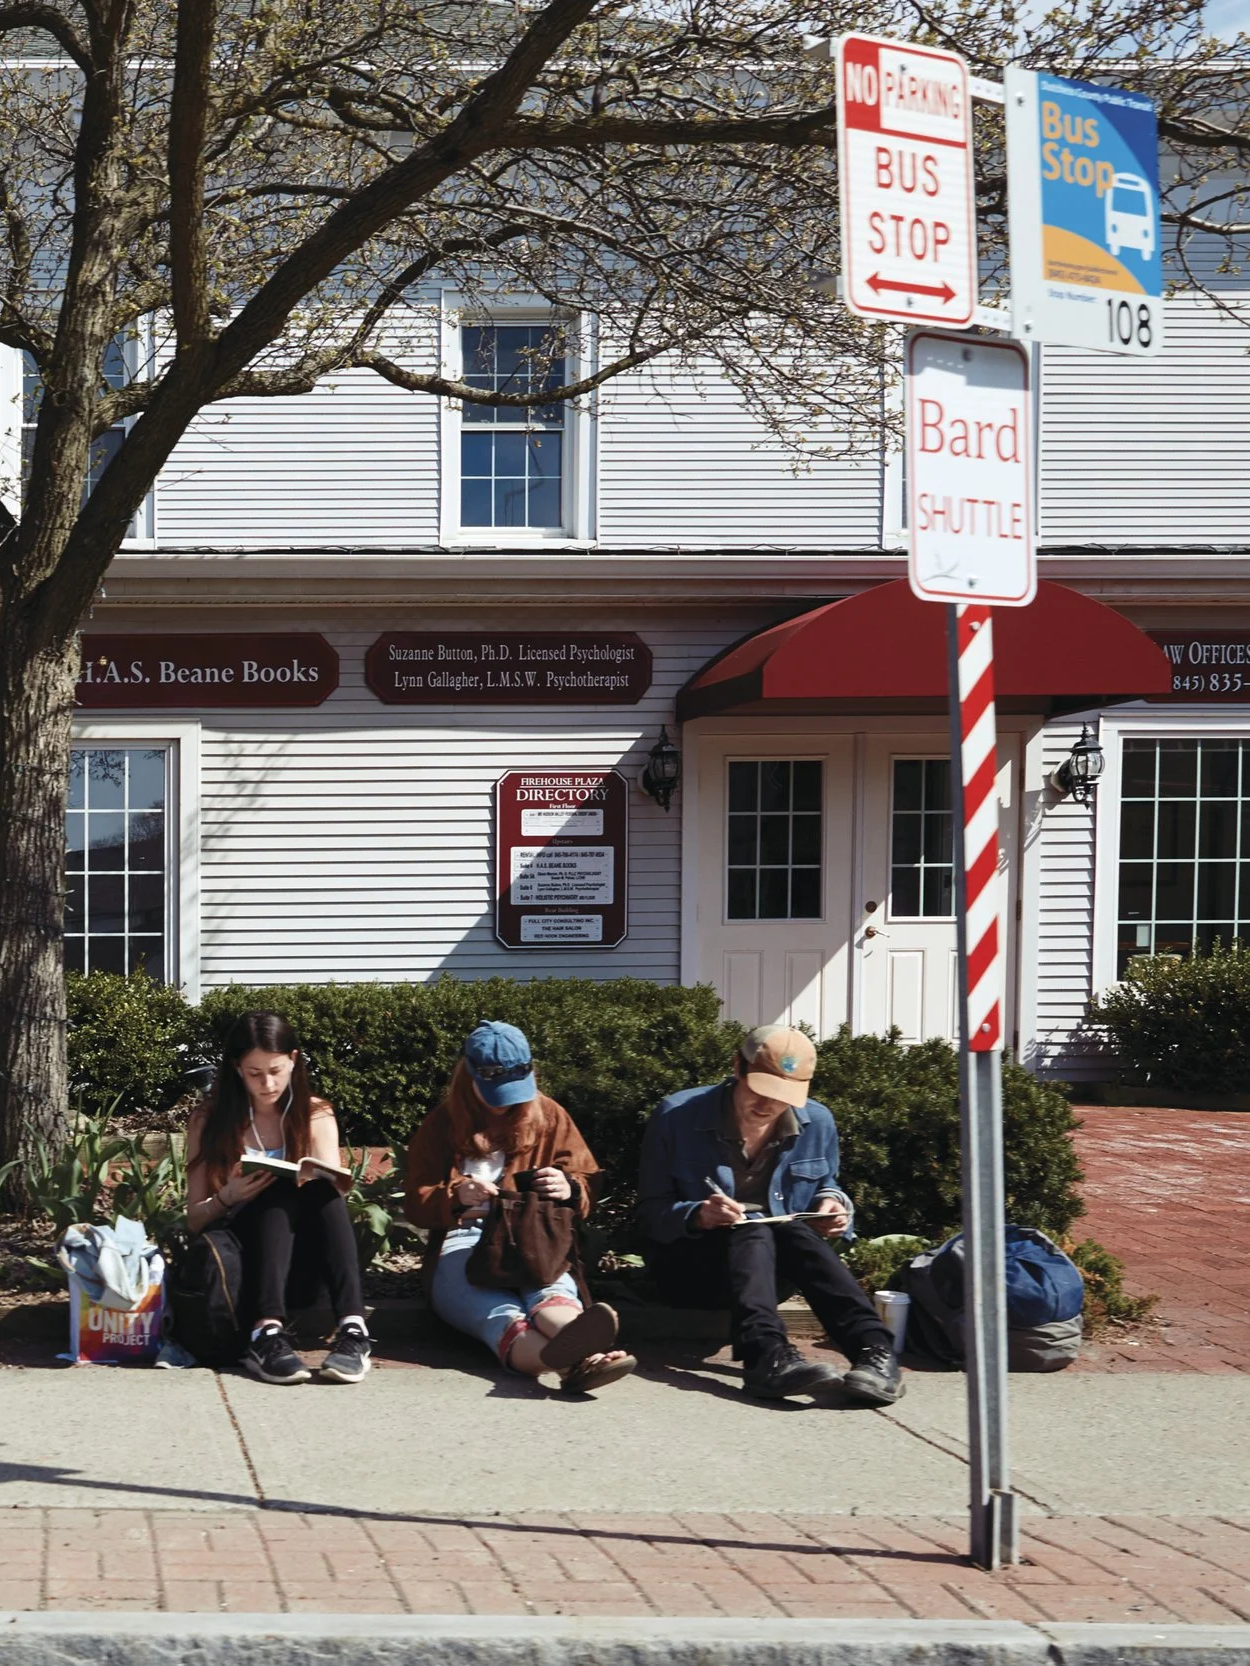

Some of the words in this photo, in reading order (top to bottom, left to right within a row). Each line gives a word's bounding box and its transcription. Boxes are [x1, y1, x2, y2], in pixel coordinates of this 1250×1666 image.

[846, 61, 878, 106] NO
[885, 70, 960, 120] PARKING
[1041, 100, 1099, 148] Bus
[876, 146, 940, 198] BUS
[1042, 142, 1115, 199] Stop
[868, 210, 950, 263] STOP
[1107, 298, 1151, 348] 108
[917, 397, 1022, 464] Bard
[918, 493, 1023, 540] SHUTTLE
[159, 661, 234, 683] Beane
[242, 659, 319, 683] Books
[389, 644, 434, 661] Suzanne
[437, 644, 478, 663] Button,
[481, 644, 513, 661] Ph.D.
[518, 644, 566, 661] Licensed
[569, 644, 635, 664] Psychologist
[394, 671, 423, 690] Lynn
[427, 671, 484, 690] Gallagher,
[487, 671, 540, 688] L.M.S.W.
[546, 671, 629, 690] Psychotherapist
[516, 789, 609, 801] DIRECTORY
[521, 778, 573, 786] FIREHOUSE
[574, 778, 604, 786] PLAZA
[88, 1307, 155, 1334] UNITY
[103, 1333, 150, 1346] PROJECT
